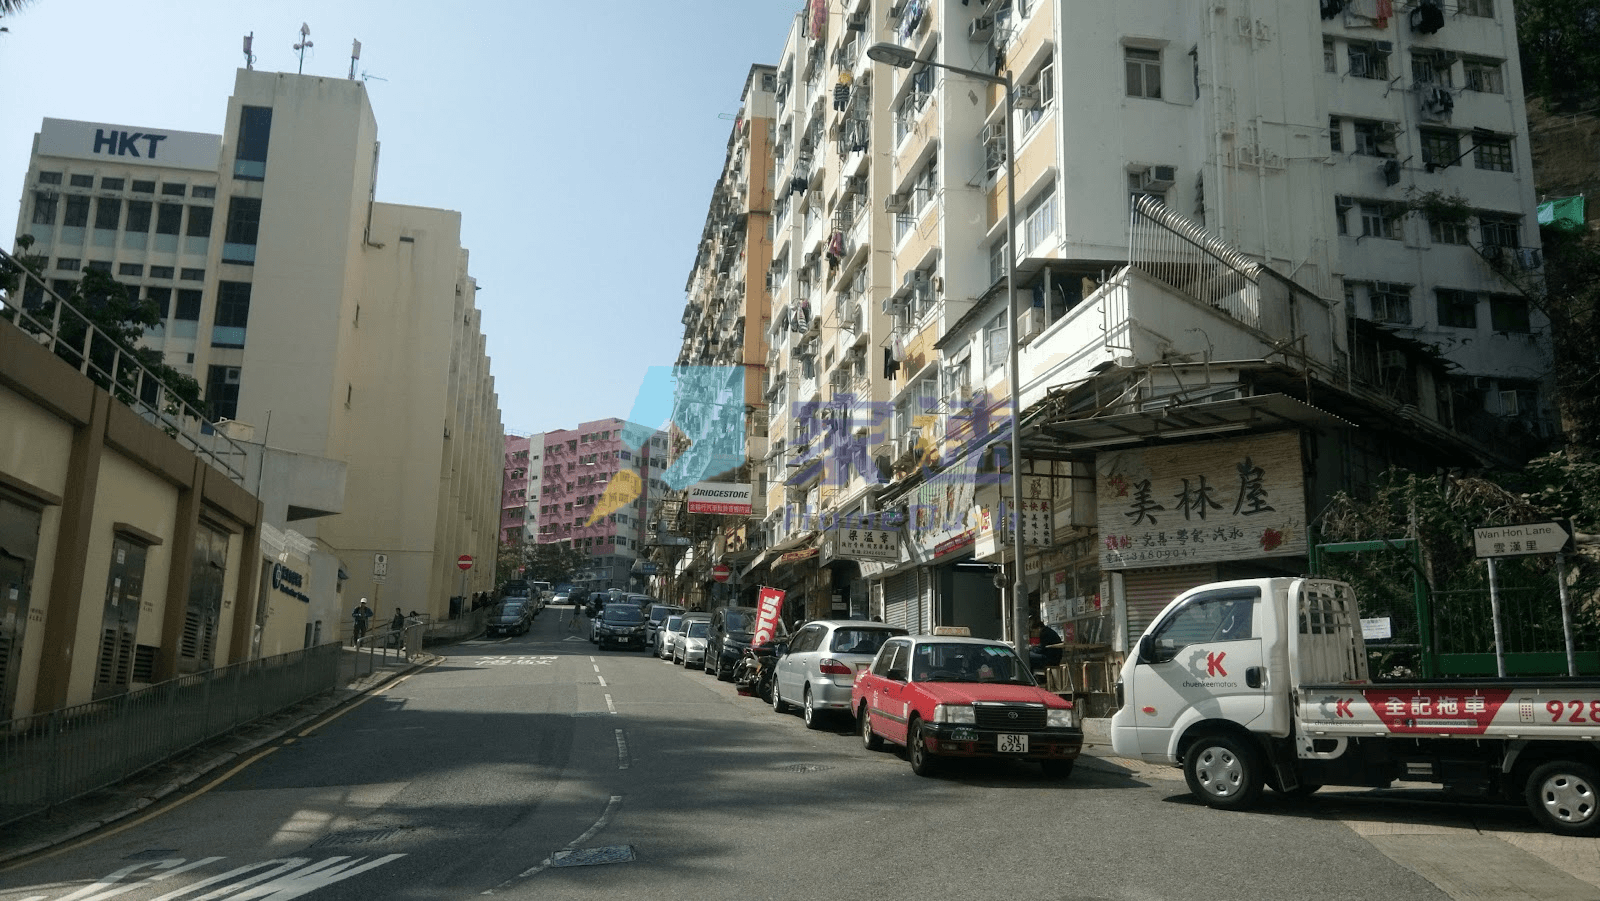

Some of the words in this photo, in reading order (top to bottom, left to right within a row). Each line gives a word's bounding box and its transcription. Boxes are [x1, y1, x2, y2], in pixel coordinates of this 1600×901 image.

[93, 128, 168, 159] HKT
[692, 488, 749, 499] BRIDGESTONE
[1124, 456, 1276, 526] 美林屋
[1477, 530, 1499, 539] Wan
[1502, 528, 1523, 537] Hon
[1525, 527, 1552, 536] Lane
[1493, 540, 1538, 553] 雲漢里
[755, 595, 780, 645] OTUL
[1384, 695, 1486, 716] 全記拖車
[1006, 734, 1021, 744] SN
[1000, 743, 1026, 752] 6251
